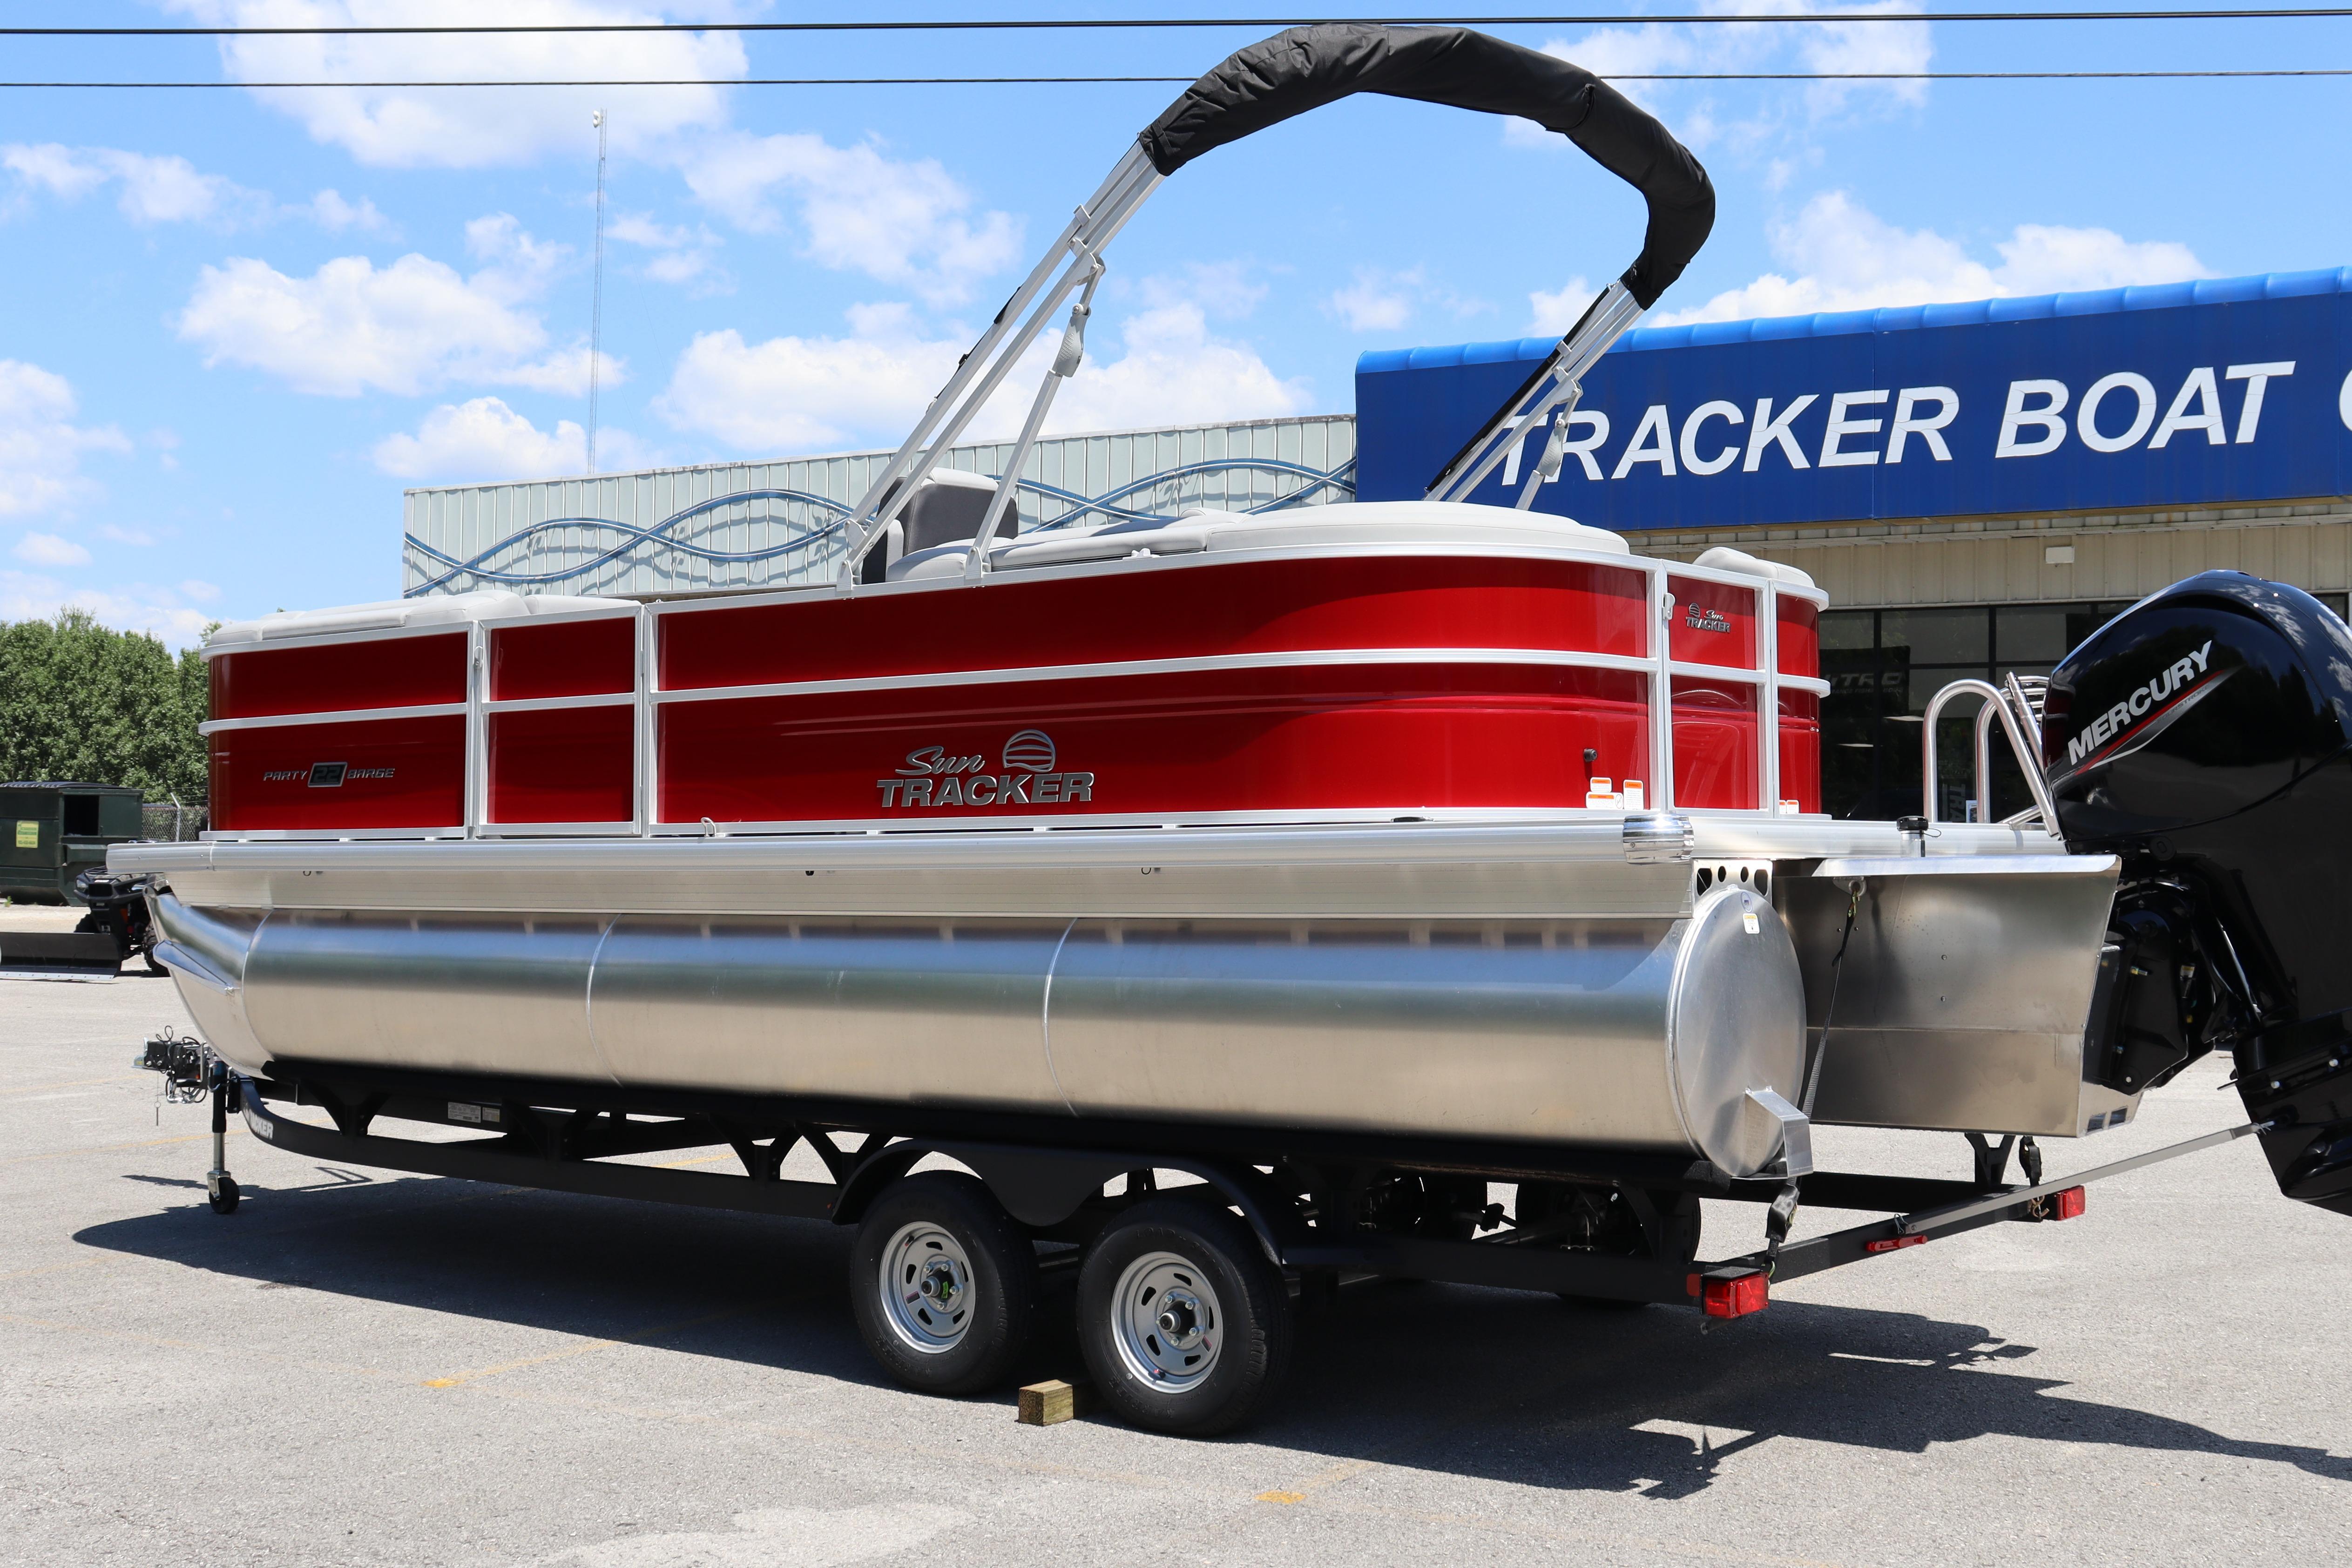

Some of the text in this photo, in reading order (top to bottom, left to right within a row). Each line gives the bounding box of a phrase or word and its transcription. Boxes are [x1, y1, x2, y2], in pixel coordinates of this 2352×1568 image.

[1502, 386, 1959, 485] TRACKER
[1995, 361, 2296, 458] BOAT
[1685, 616, 1730, 633] TRACKER
[2068, 640, 2212, 765] MERCURY
[2156, 685, 2209, 723] FOURSTROKE
[263, 766, 395, 783] PARTY 22 BARGE
[895, 746, 985, 775] Sun
[877, 772, 1095, 807] TRACKER
